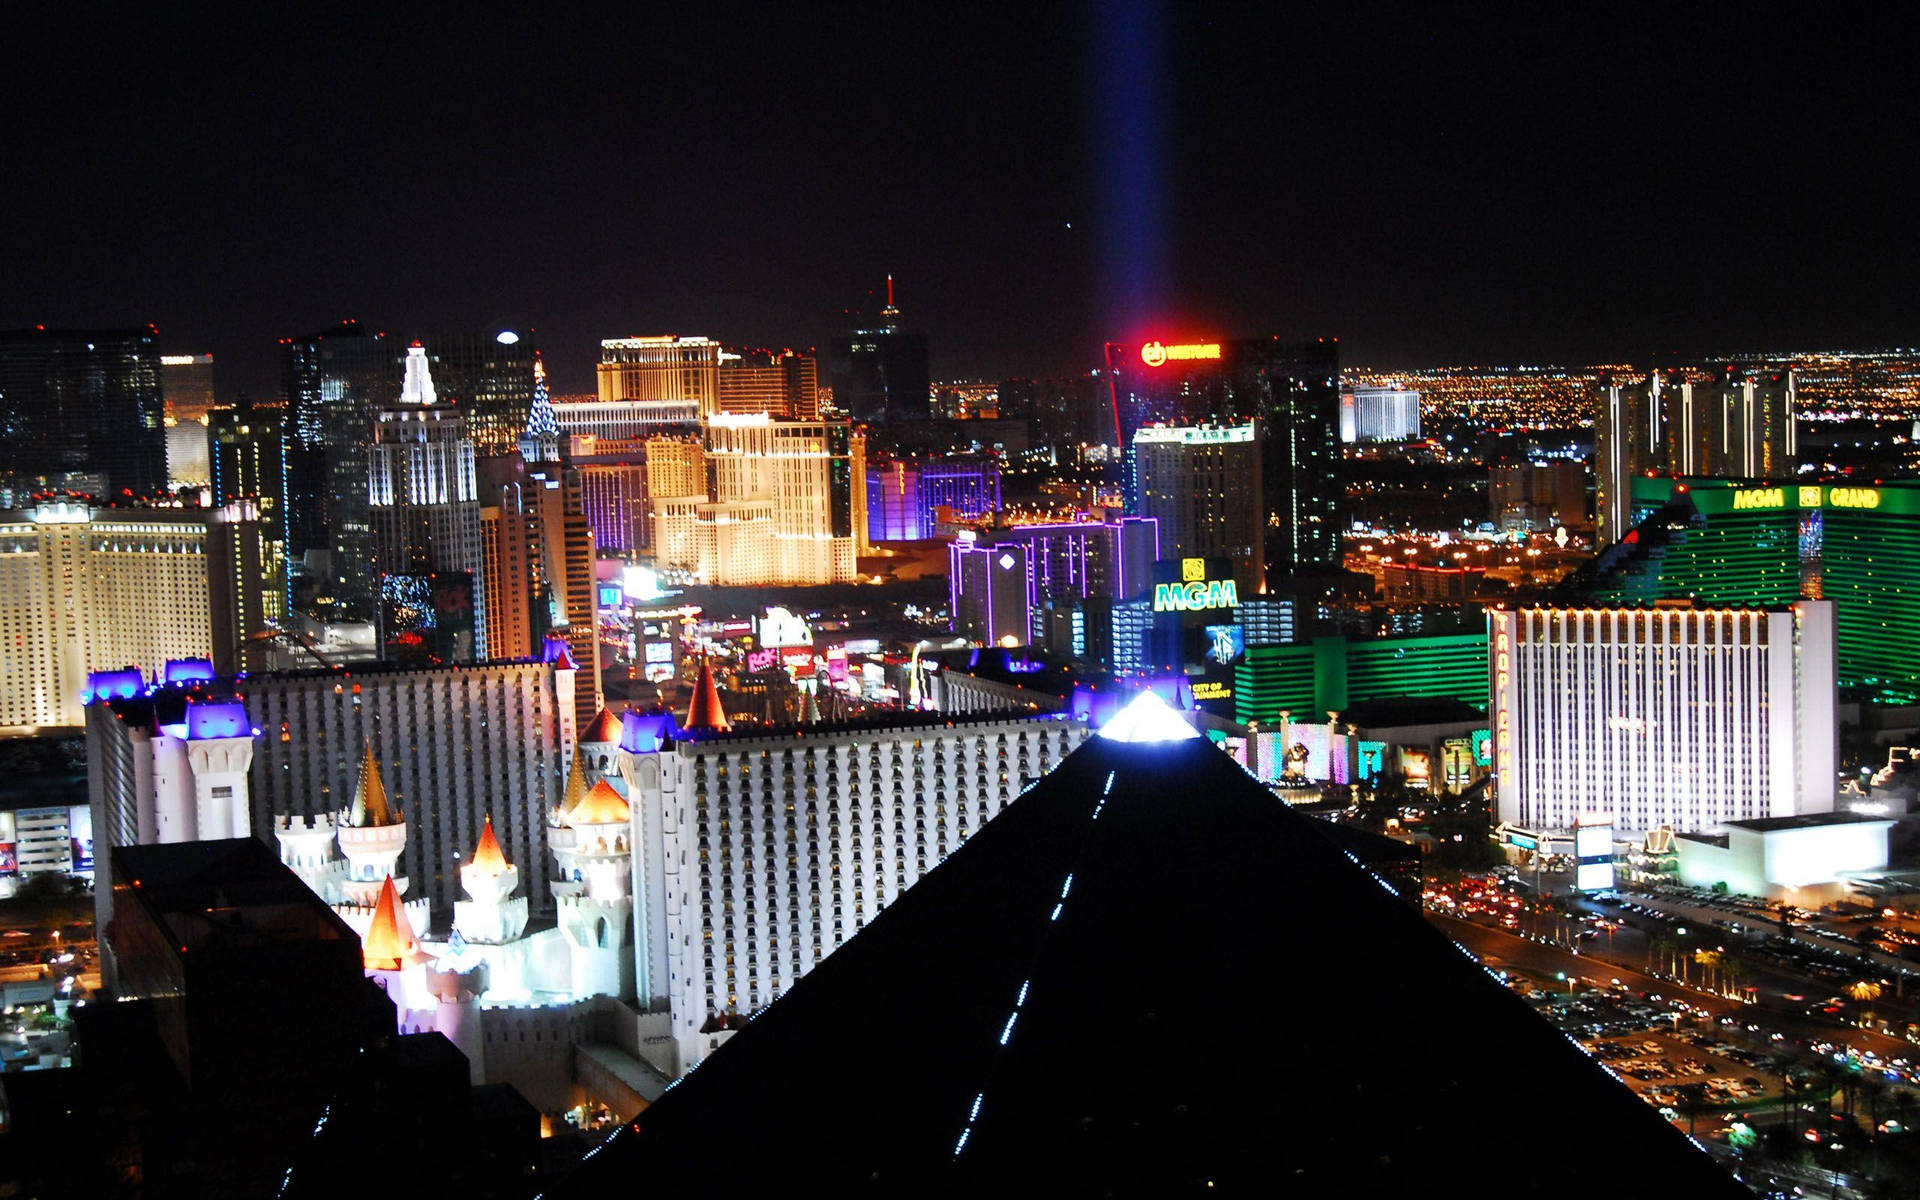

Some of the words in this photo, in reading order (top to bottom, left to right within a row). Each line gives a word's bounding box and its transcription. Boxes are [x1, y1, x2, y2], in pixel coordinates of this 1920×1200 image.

[1733, 488, 1784, 510] MGM
[1830, 487, 1879, 509] GRAND
[1153, 579, 1238, 612] MGM
[1192, 683, 1210, 693] CITY
[1210, 682, 1223, 692] OF
[1497, 613, 1511, 786] TROPICANA
